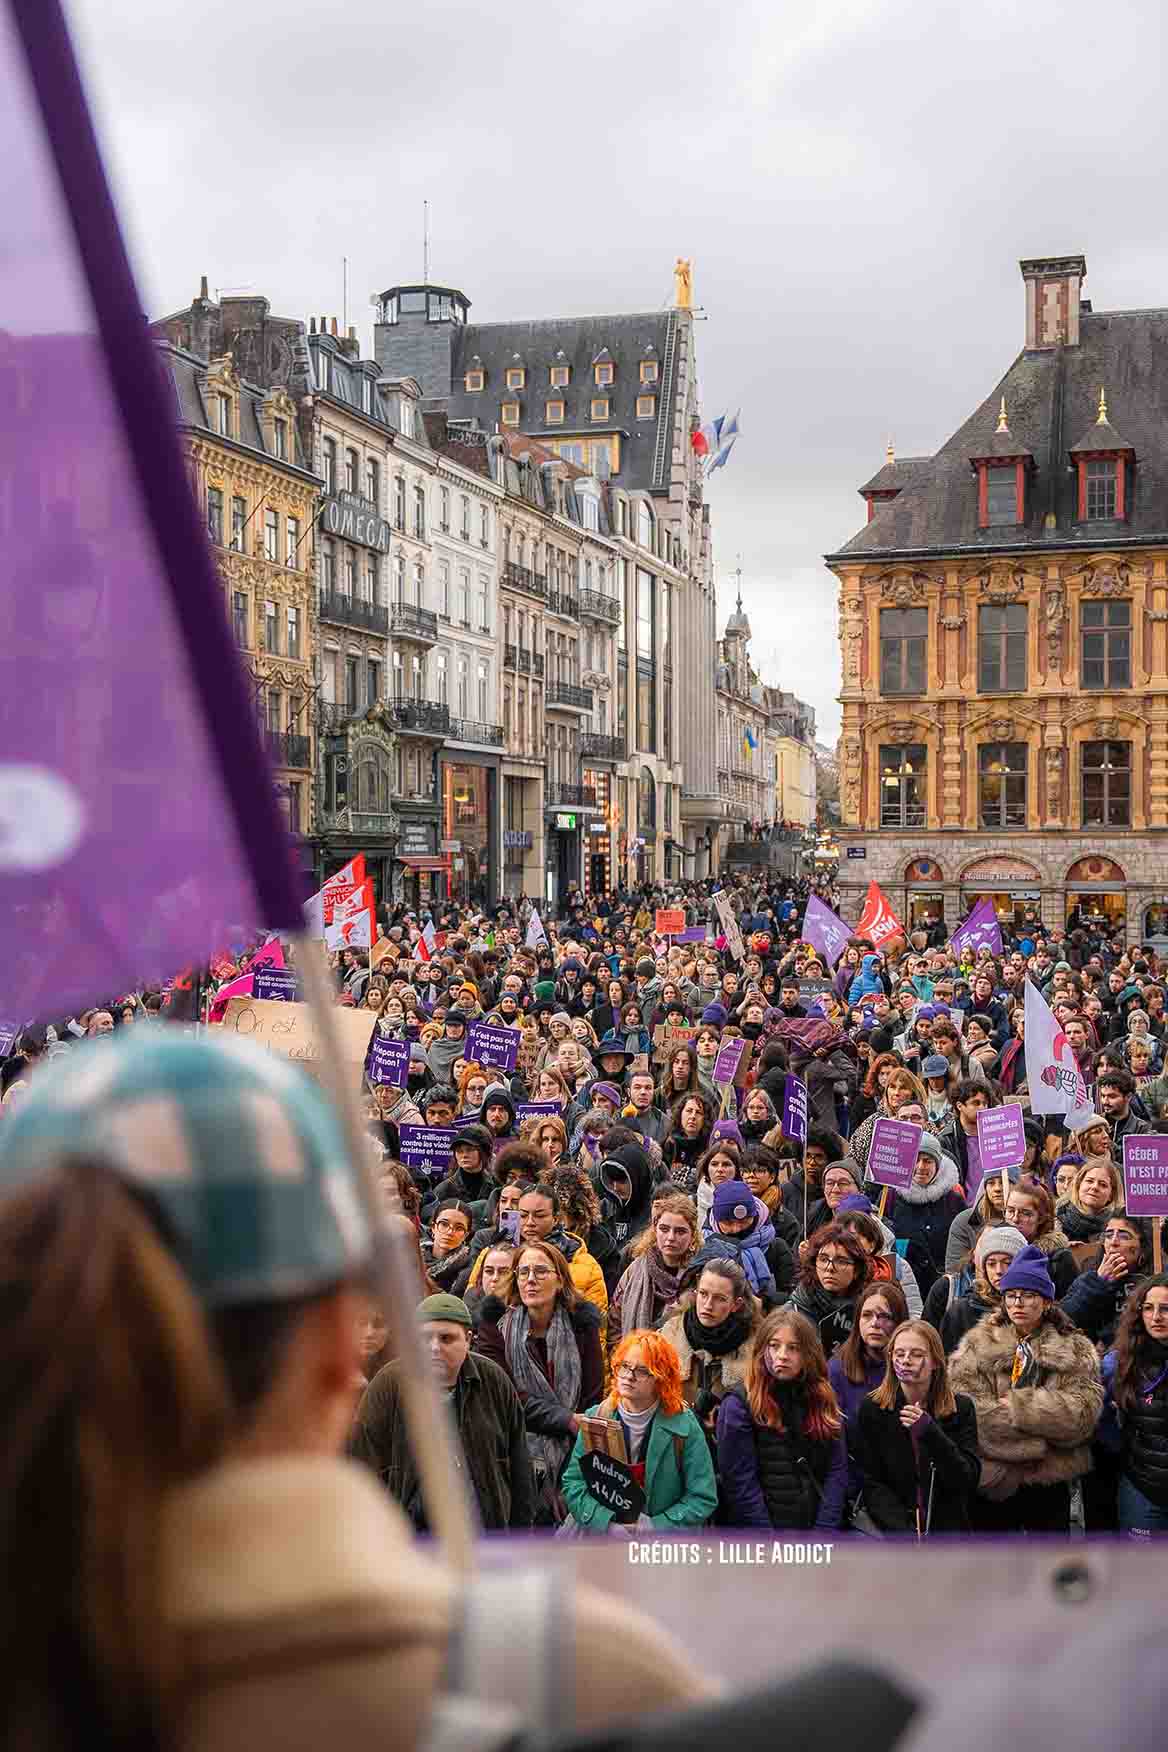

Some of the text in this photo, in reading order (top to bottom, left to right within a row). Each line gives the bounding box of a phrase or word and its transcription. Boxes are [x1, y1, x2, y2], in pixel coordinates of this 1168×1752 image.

[329, 502, 387, 550] OMEGA
[475, 1032, 490, 1041] c'est
[490, 1036, 503, 1044] pas
[475, 1039, 490, 1049] c'est
[382, 1058, 396, 1067] non
[416, 1132, 422, 1140] 3
[402, 1140, 423, 1148] contre
[423, 1140, 433, 1148] les
[400, 1146, 426, 1155] sexistes
[1129, 1165, 1154, 1178] N'EST
[592, 1455, 631, 1488] Audrey
